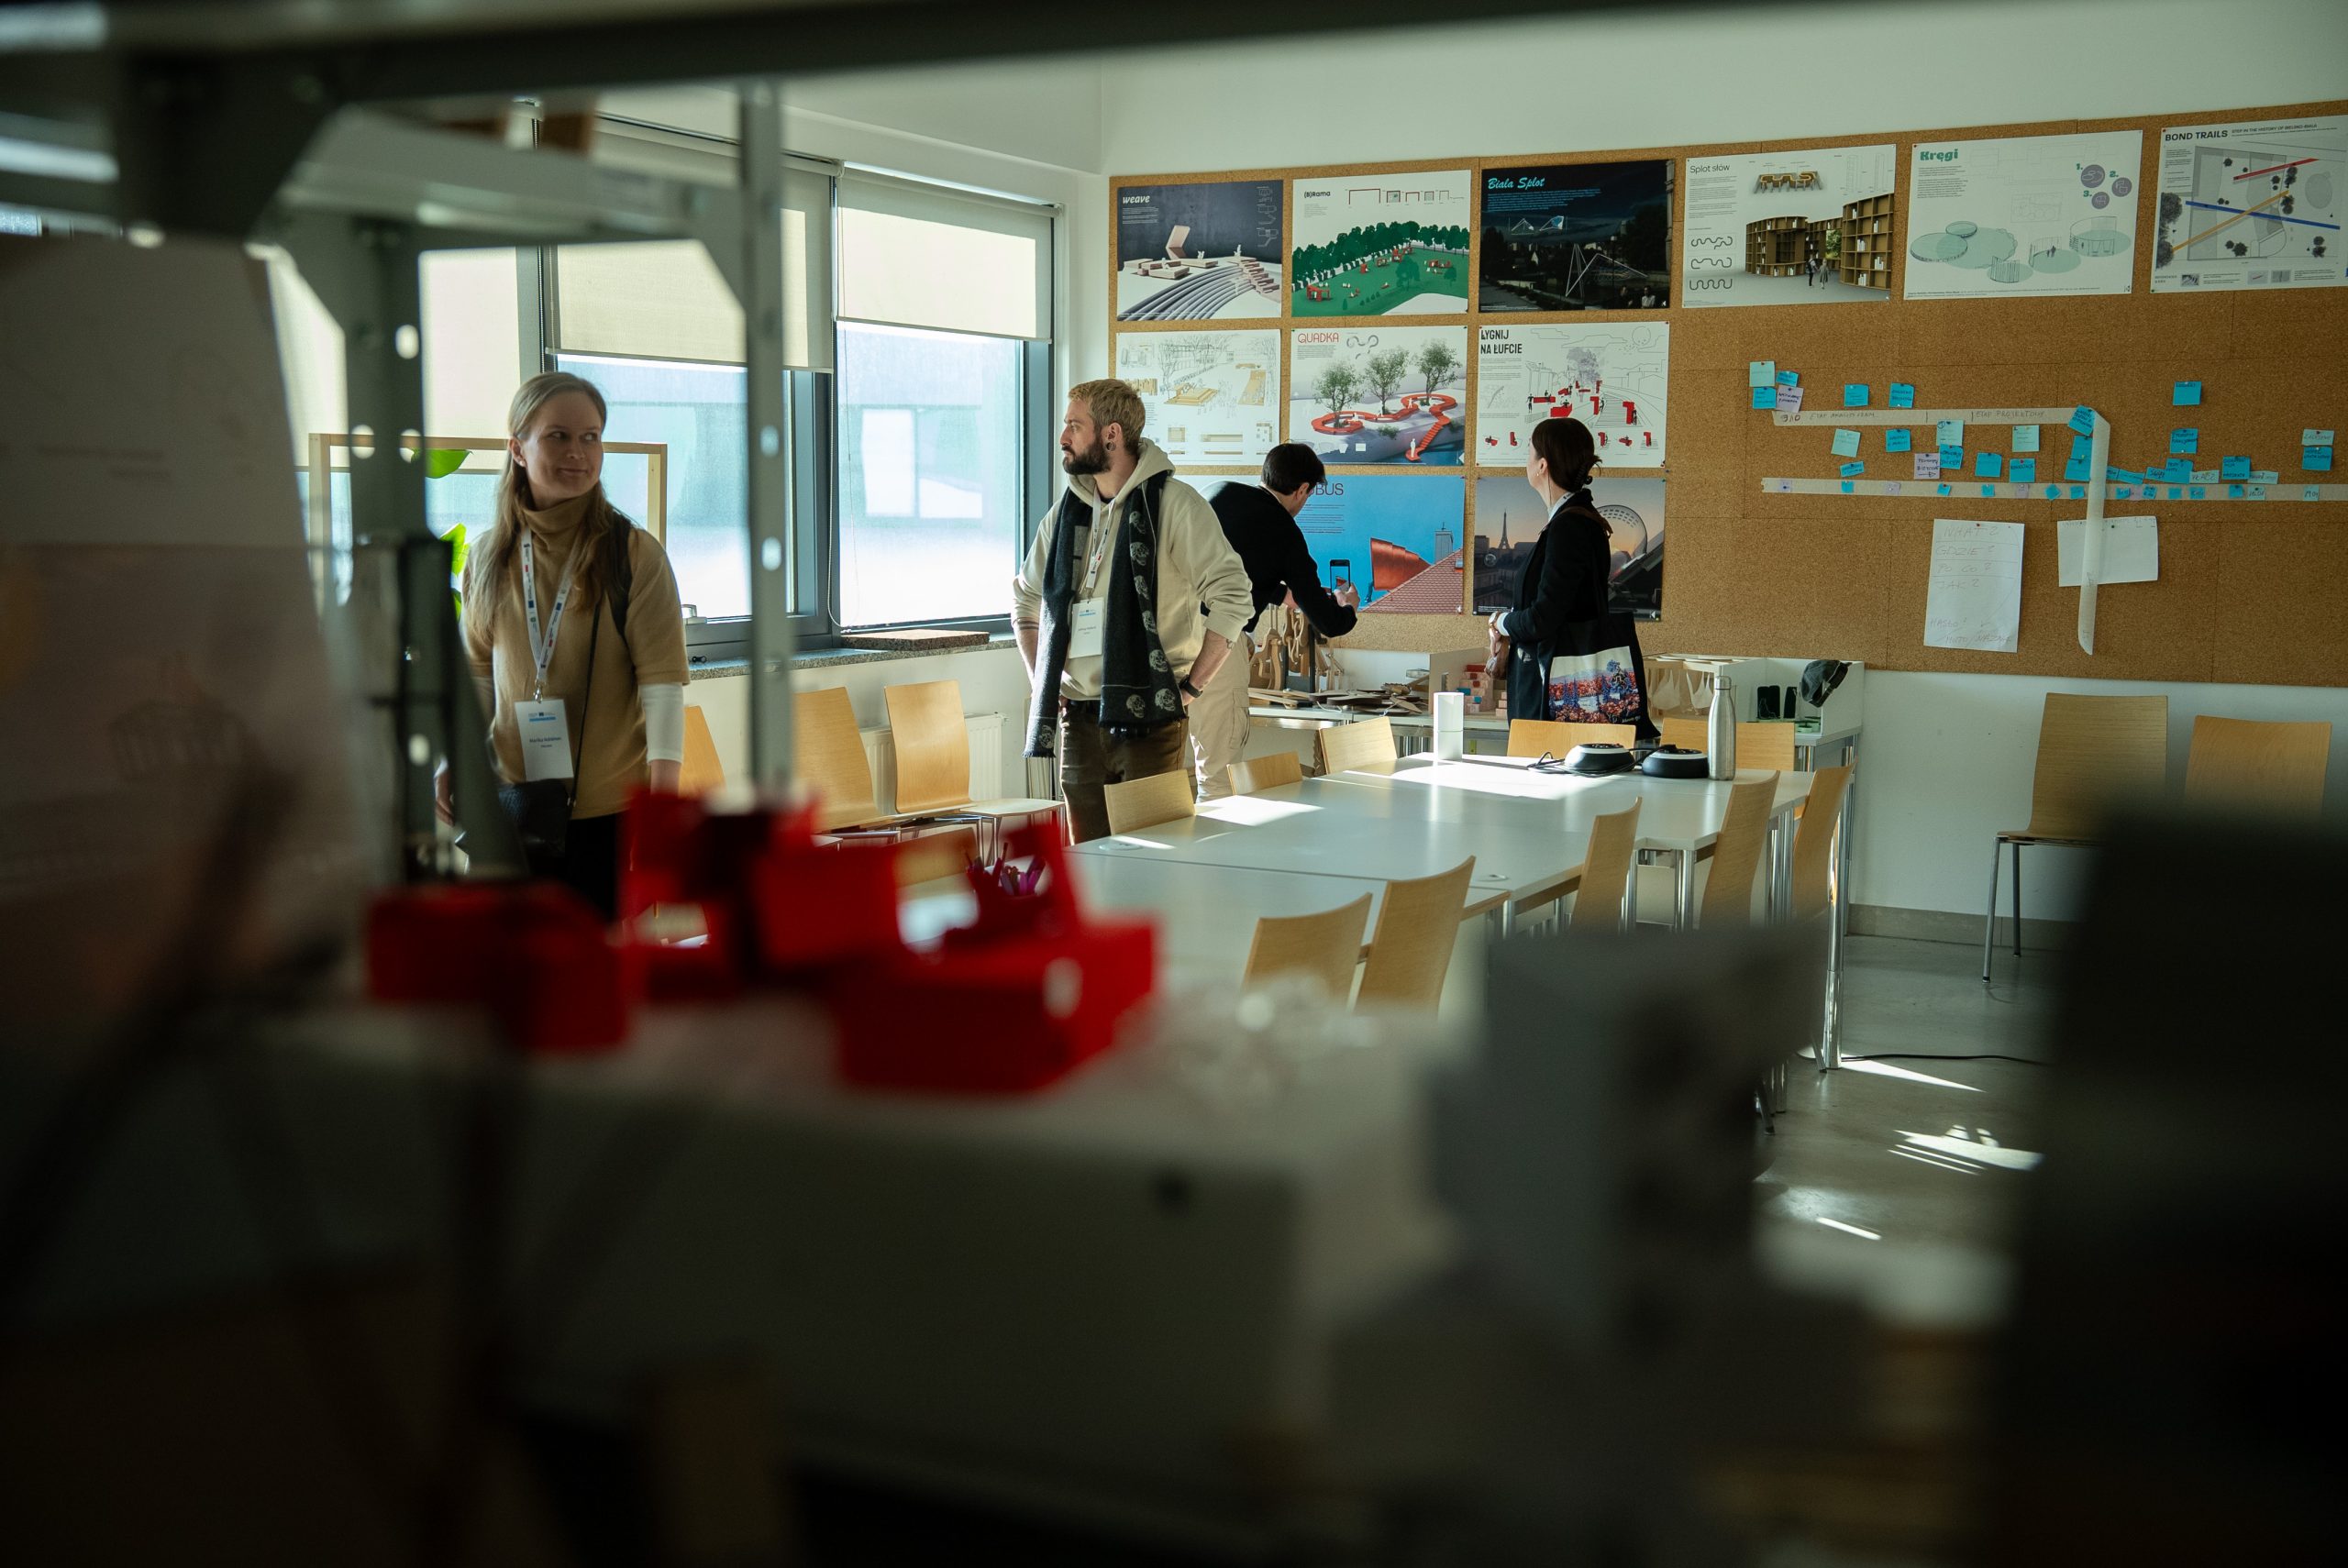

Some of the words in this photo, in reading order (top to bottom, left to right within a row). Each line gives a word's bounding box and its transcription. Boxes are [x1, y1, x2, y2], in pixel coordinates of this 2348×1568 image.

[2165, 131, 2193, 142] BOND
[2196, 129, 2229, 139] TRAILS
[1920, 149, 1958, 162] Kręgi
[1689, 164, 1711, 174] Splot
[2109, 170, 2119, 178] 2.
[1516, 176, 1545, 191] Splot
[1122, 194, 1151, 204] weave
[1303, 191, 1331, 199] (B)Rama
[1297, 332, 1339, 344] QUADKA
[1480, 329, 1509, 340] ŁYGNIJ
[1479, 344, 1491, 354] NA
[1493, 343, 1523, 354] ŁUFCIE
